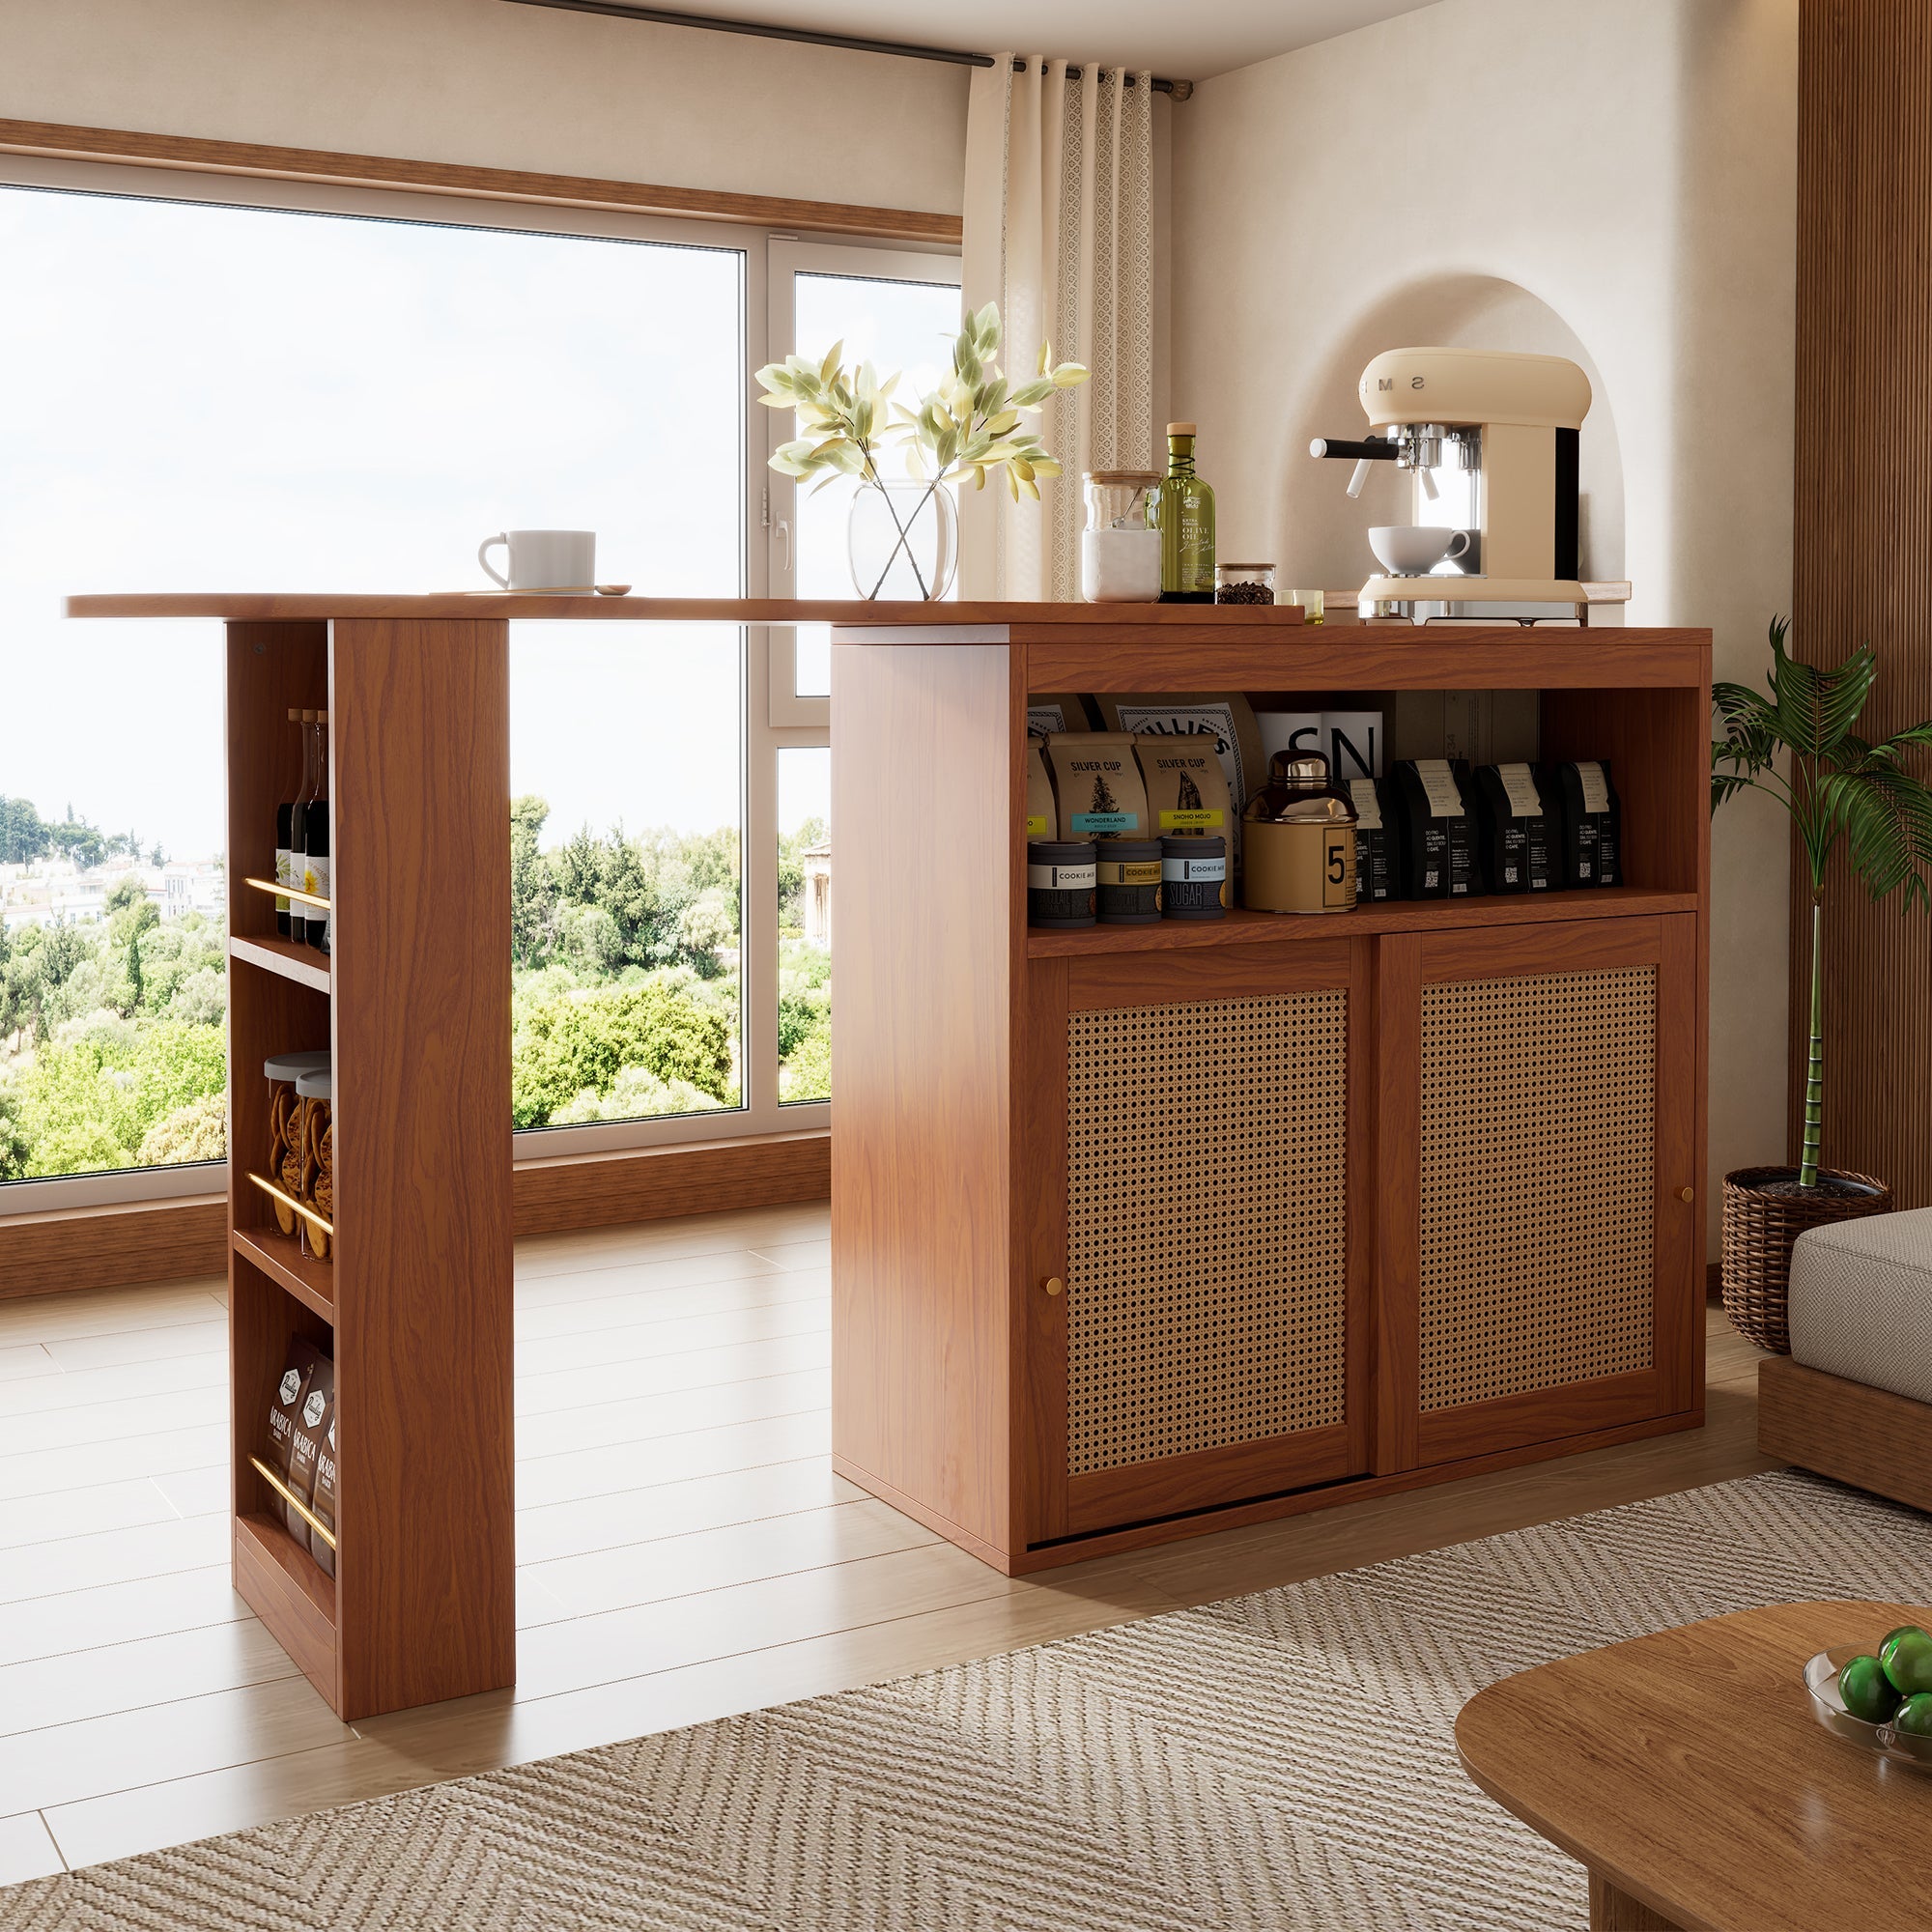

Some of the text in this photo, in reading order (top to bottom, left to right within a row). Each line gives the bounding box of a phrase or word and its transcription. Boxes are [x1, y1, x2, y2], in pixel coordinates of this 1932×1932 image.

[1070, 761, 1122, 771] SILVER CUP
[1156, 758, 1206, 769] SILVER CUP
[1327, 846, 1345, 884] 5
[1169, 883, 1203, 906] SUGAR
[270, 1406, 292, 1438] ARABICA
[293, 1428, 317, 1462] ARABICA
[318, 1451, 335, 1483] ARABI
